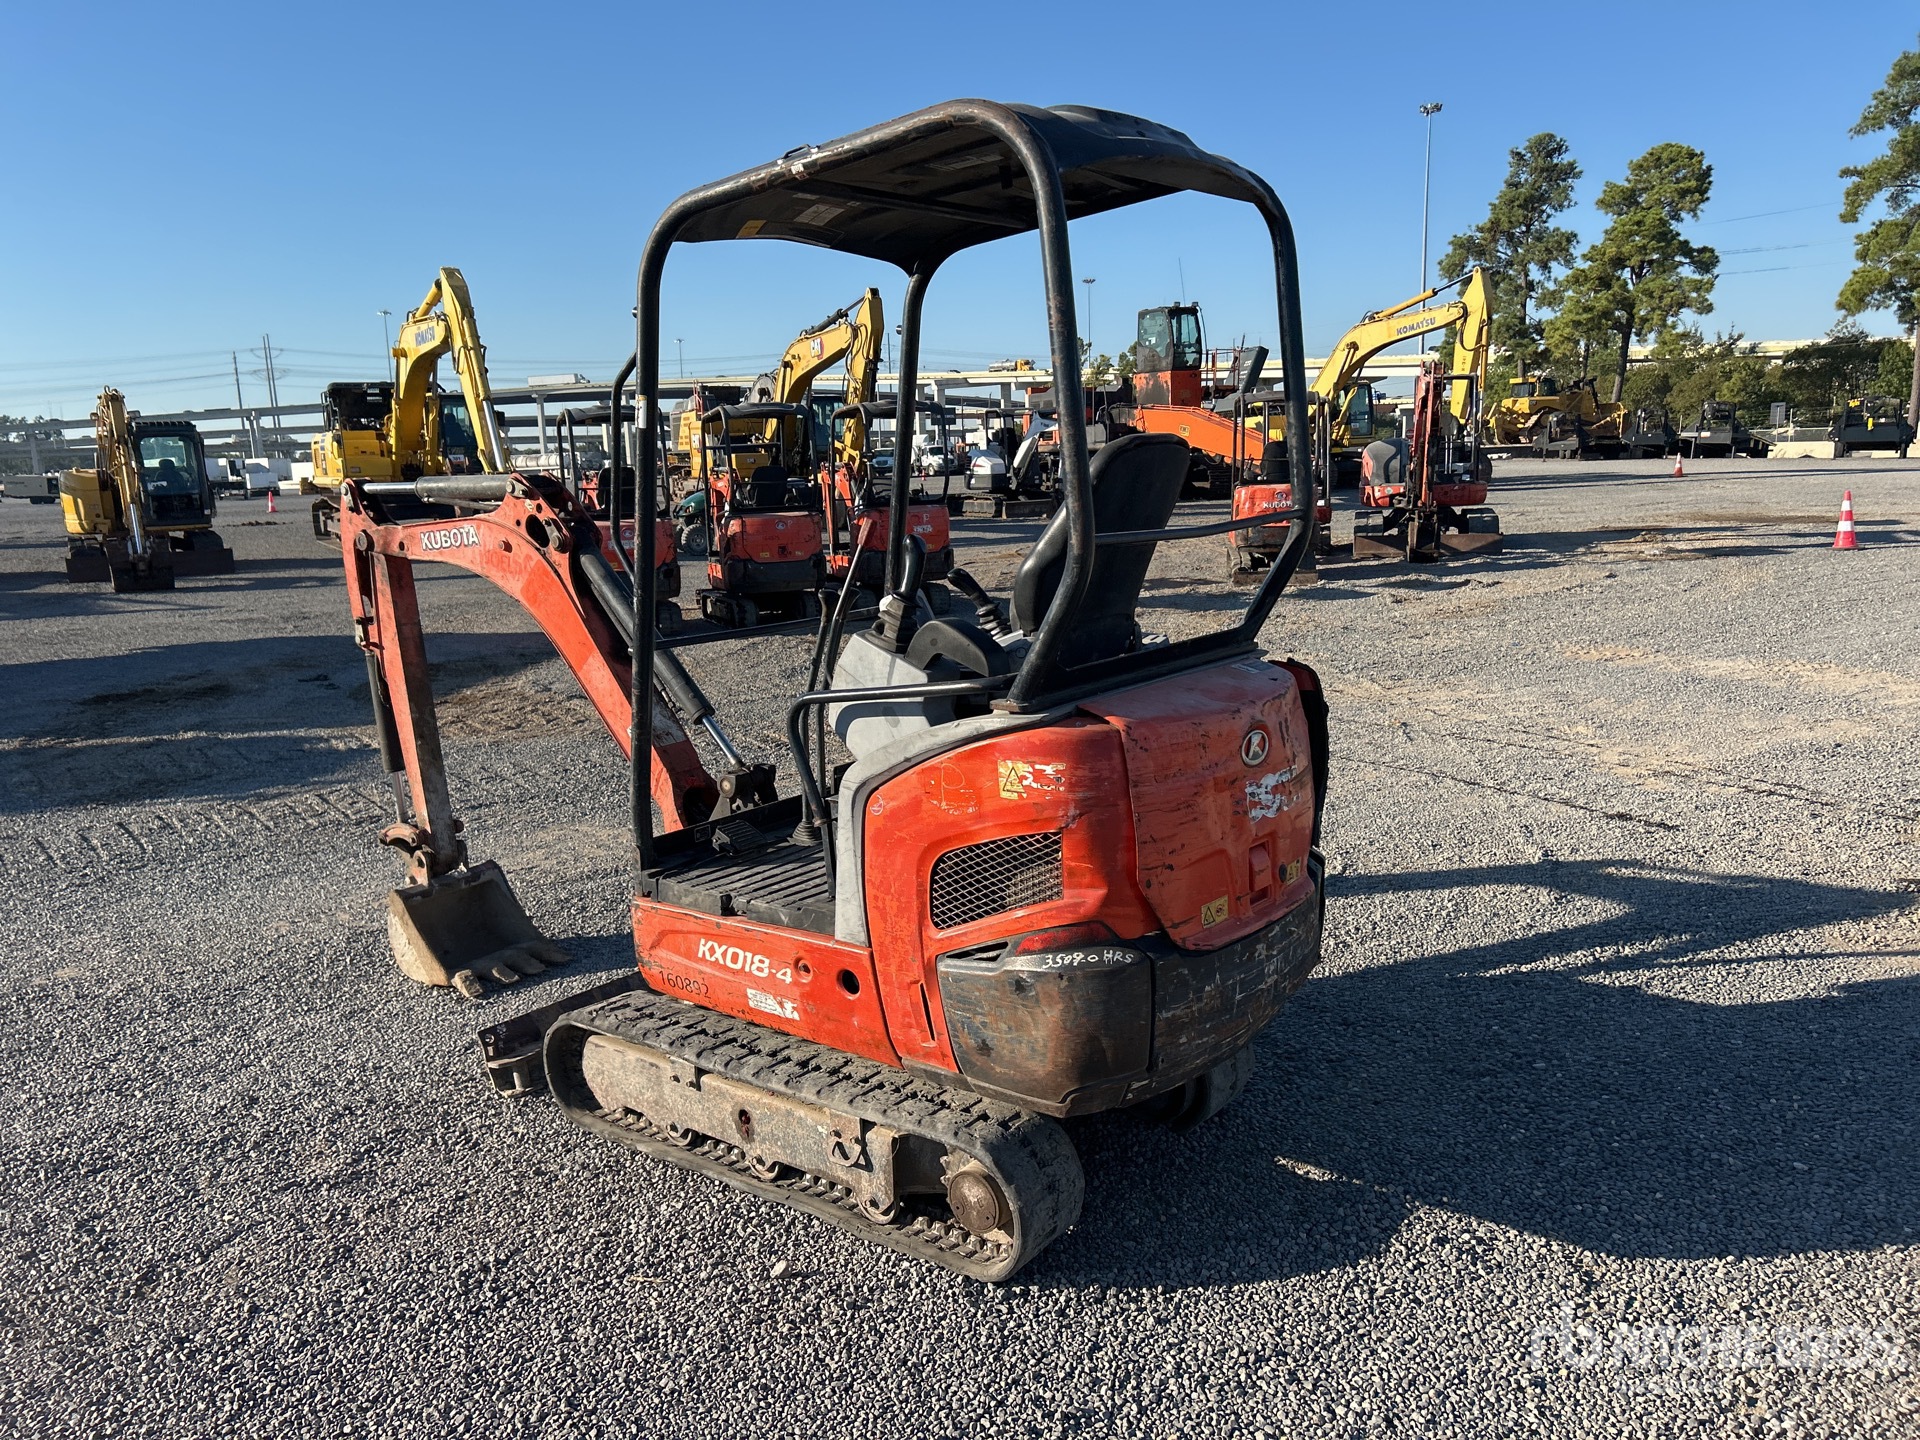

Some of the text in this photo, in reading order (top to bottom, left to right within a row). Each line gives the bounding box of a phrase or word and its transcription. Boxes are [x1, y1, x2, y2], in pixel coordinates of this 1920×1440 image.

[1397, 317, 1436, 336] KOMATSU
[420, 525, 480, 551] KUBOTA
[698, 938, 793, 984] KX018-4
[1103, 949, 1134, 965] HRS
[659, 970, 711, 999] 160892
